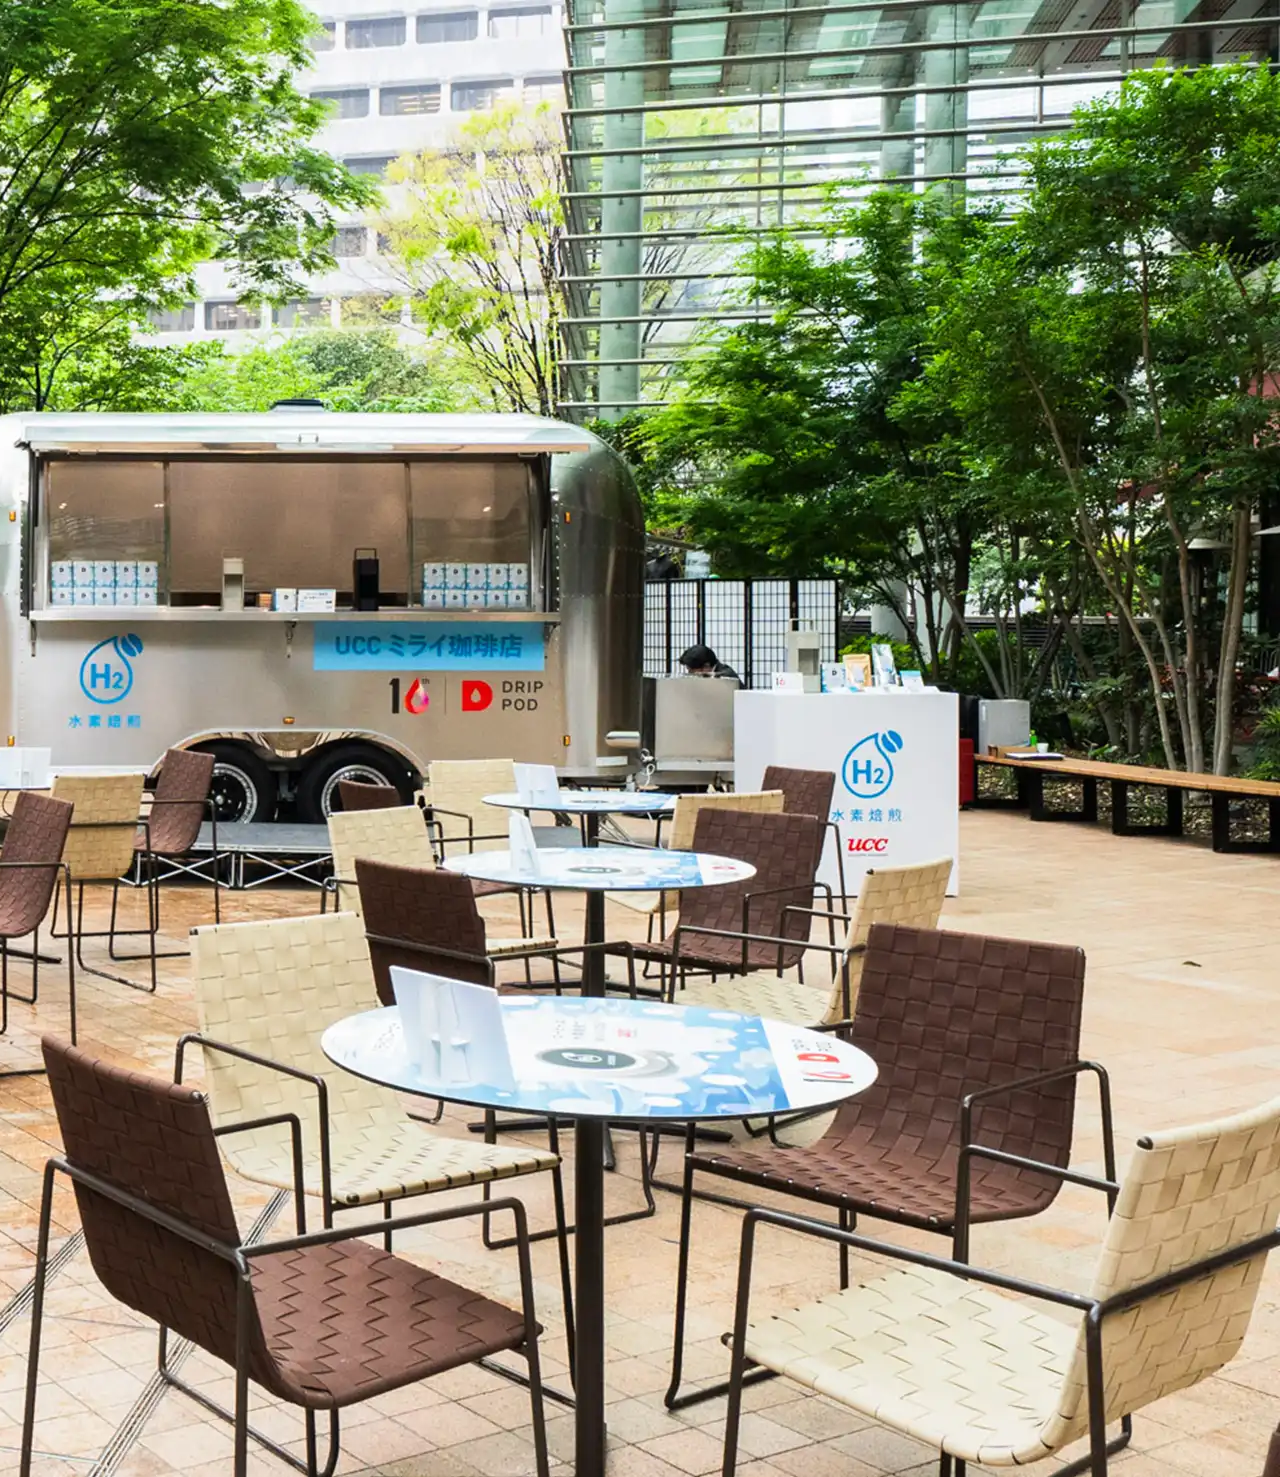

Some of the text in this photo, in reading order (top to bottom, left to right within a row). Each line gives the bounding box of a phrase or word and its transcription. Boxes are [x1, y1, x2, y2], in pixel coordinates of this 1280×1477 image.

[335, 634, 523, 658] UCC ミライ珈琲店
[90, 663, 124, 689] H2
[502, 681, 543, 693] DRIP
[502, 699, 538, 711] POD
[853, 760, 884, 784] H2
[831, 808, 902, 822] 水素焙煎
